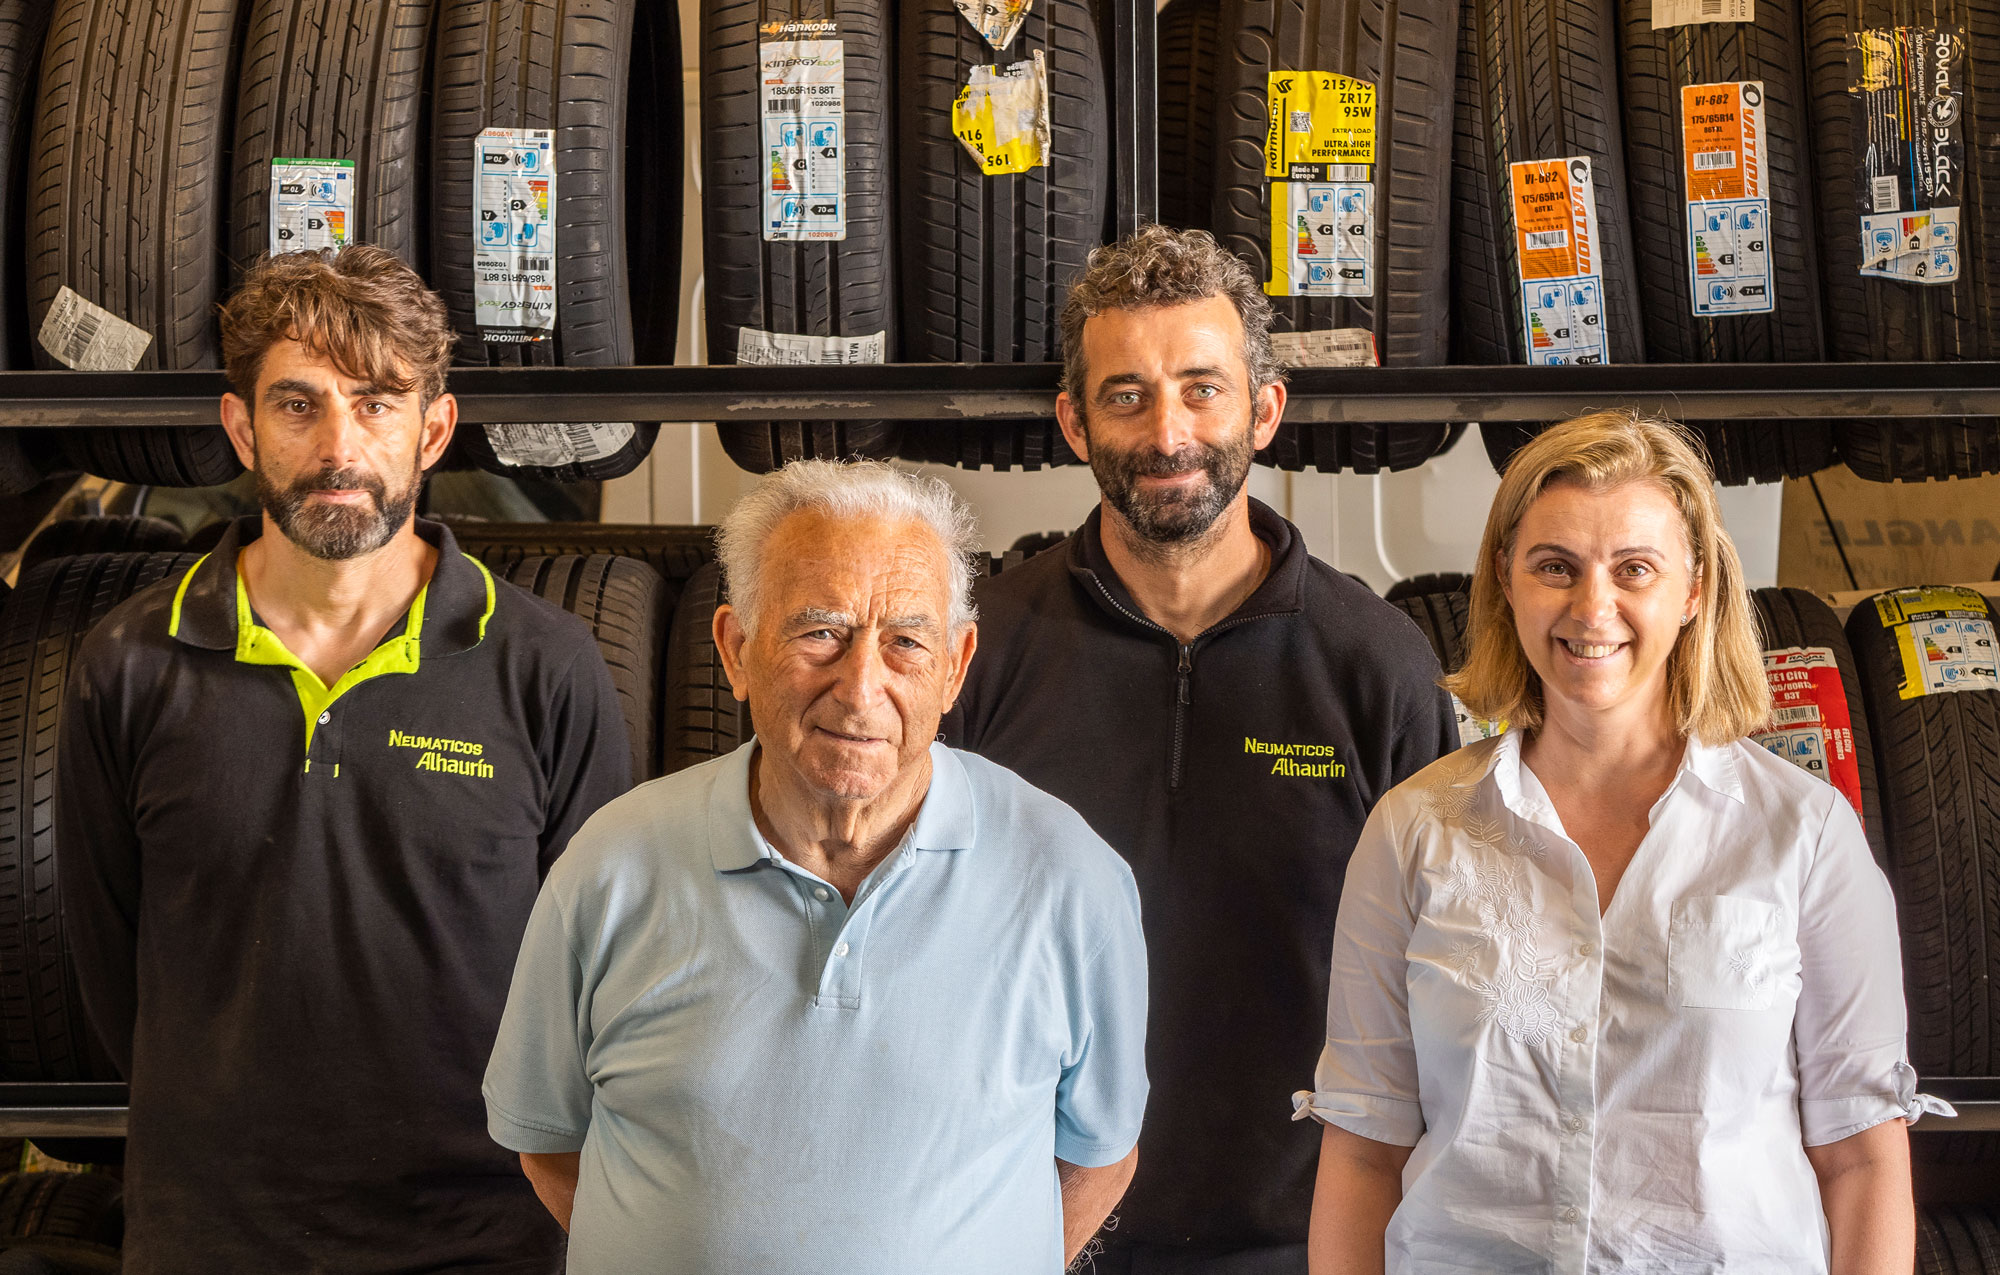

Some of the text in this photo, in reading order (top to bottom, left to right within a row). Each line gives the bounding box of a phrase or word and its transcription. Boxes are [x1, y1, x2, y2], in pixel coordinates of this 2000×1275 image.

[1935, 33, 1950, 96] ROYAL
[771, 86, 835, 95] 185/65R15 88T
[1339, 93, 1372, 104] ZR17
[1695, 94, 1729, 106] VI-682
[1344, 106, 1372, 118] 95W
[1692, 113, 1735, 125] 175/65R14
[1324, 140, 1371, 148] ULTRA HIGH
[826, 148, 835, 157] A
[1311, 149, 1371, 157] PERFORMANCE
[987, 154, 1009, 167] 195
[1934, 128, 1951, 198] BLACK
[1291, 165, 1320, 173] Made in
[1521, 191, 1564, 204] 175/65R14
[483, 212, 492, 220] A
[311, 220, 318, 228] E
[1323, 225, 1331, 234] C
[1354, 225, 1362, 234] C
[281, 230, 288, 239] C
[1753, 243, 1761, 251] C
[1910, 241, 1919, 250] E
[1724, 255, 1732, 264] E
[483, 273, 546, 282] 185/65R15 88T
[1588, 316, 1596, 324] C
[1561, 329, 1568, 337] E
[1785, 670, 1809, 681] City
[388, 729, 483, 756] NEUMATICOS
[1244, 736, 1335, 757] NEUMATICOS
[415, 751, 494, 779] Alhaurín
[1271, 757, 1346, 778] Alhaurín
